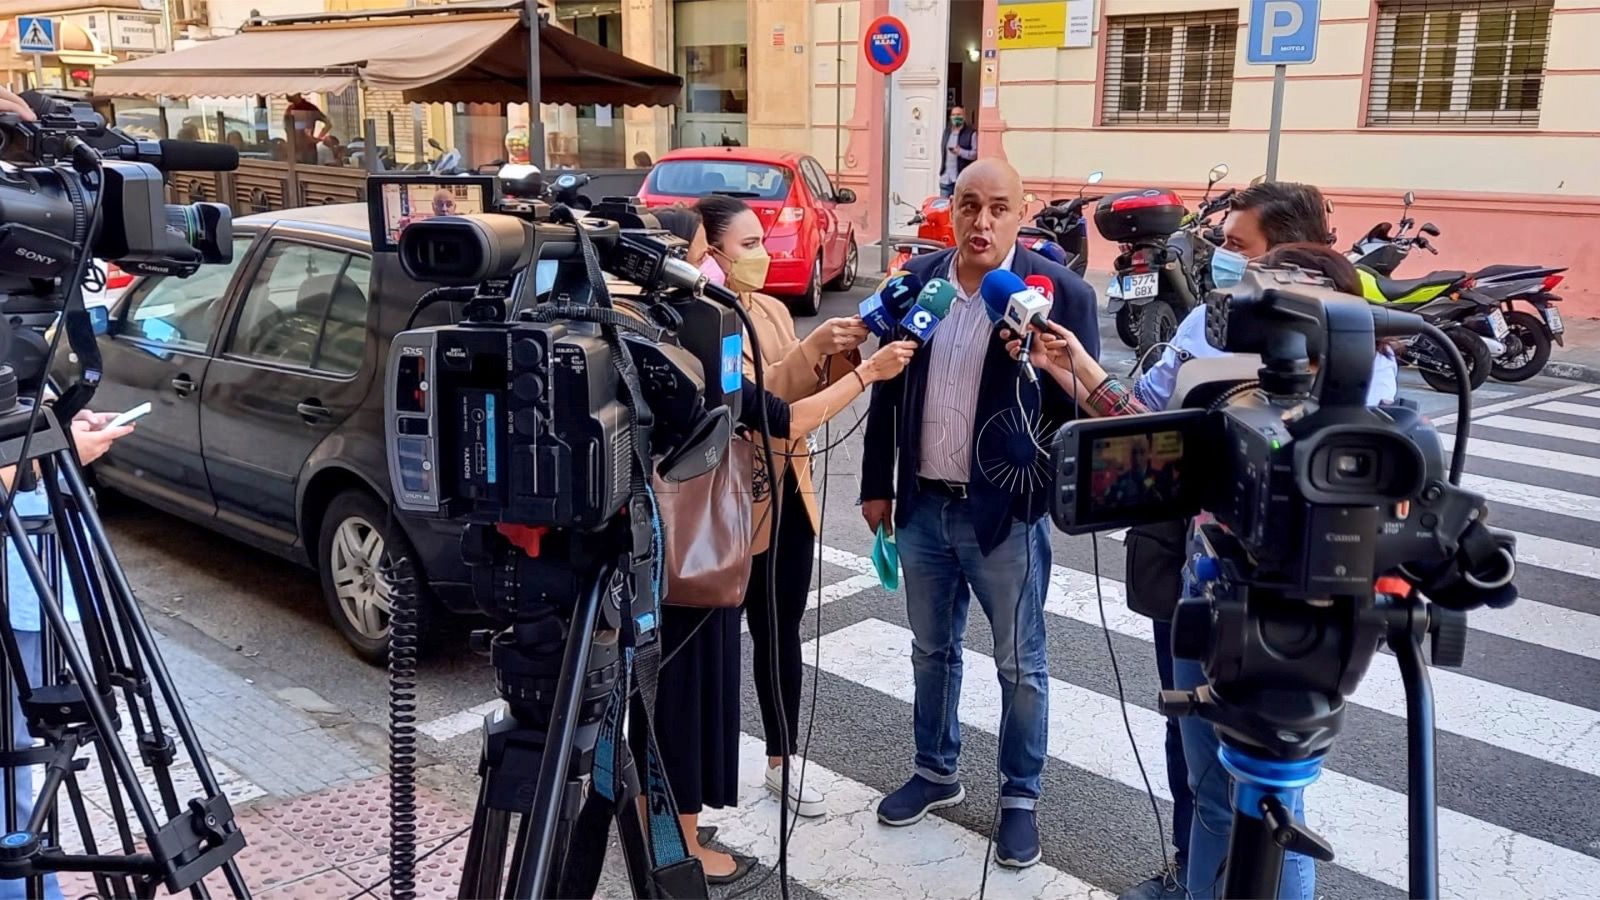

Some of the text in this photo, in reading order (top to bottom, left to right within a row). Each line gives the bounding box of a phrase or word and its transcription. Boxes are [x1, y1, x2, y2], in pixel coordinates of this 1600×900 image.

[1261, 1, 1304, 56] P
[15, 247, 57, 265] SONY
[138, 262, 169, 273] Canon
[1135, 286, 1153, 297] GBX
[907, 323, 923, 337] COPE
[1325, 532, 1361, 543] Canon
